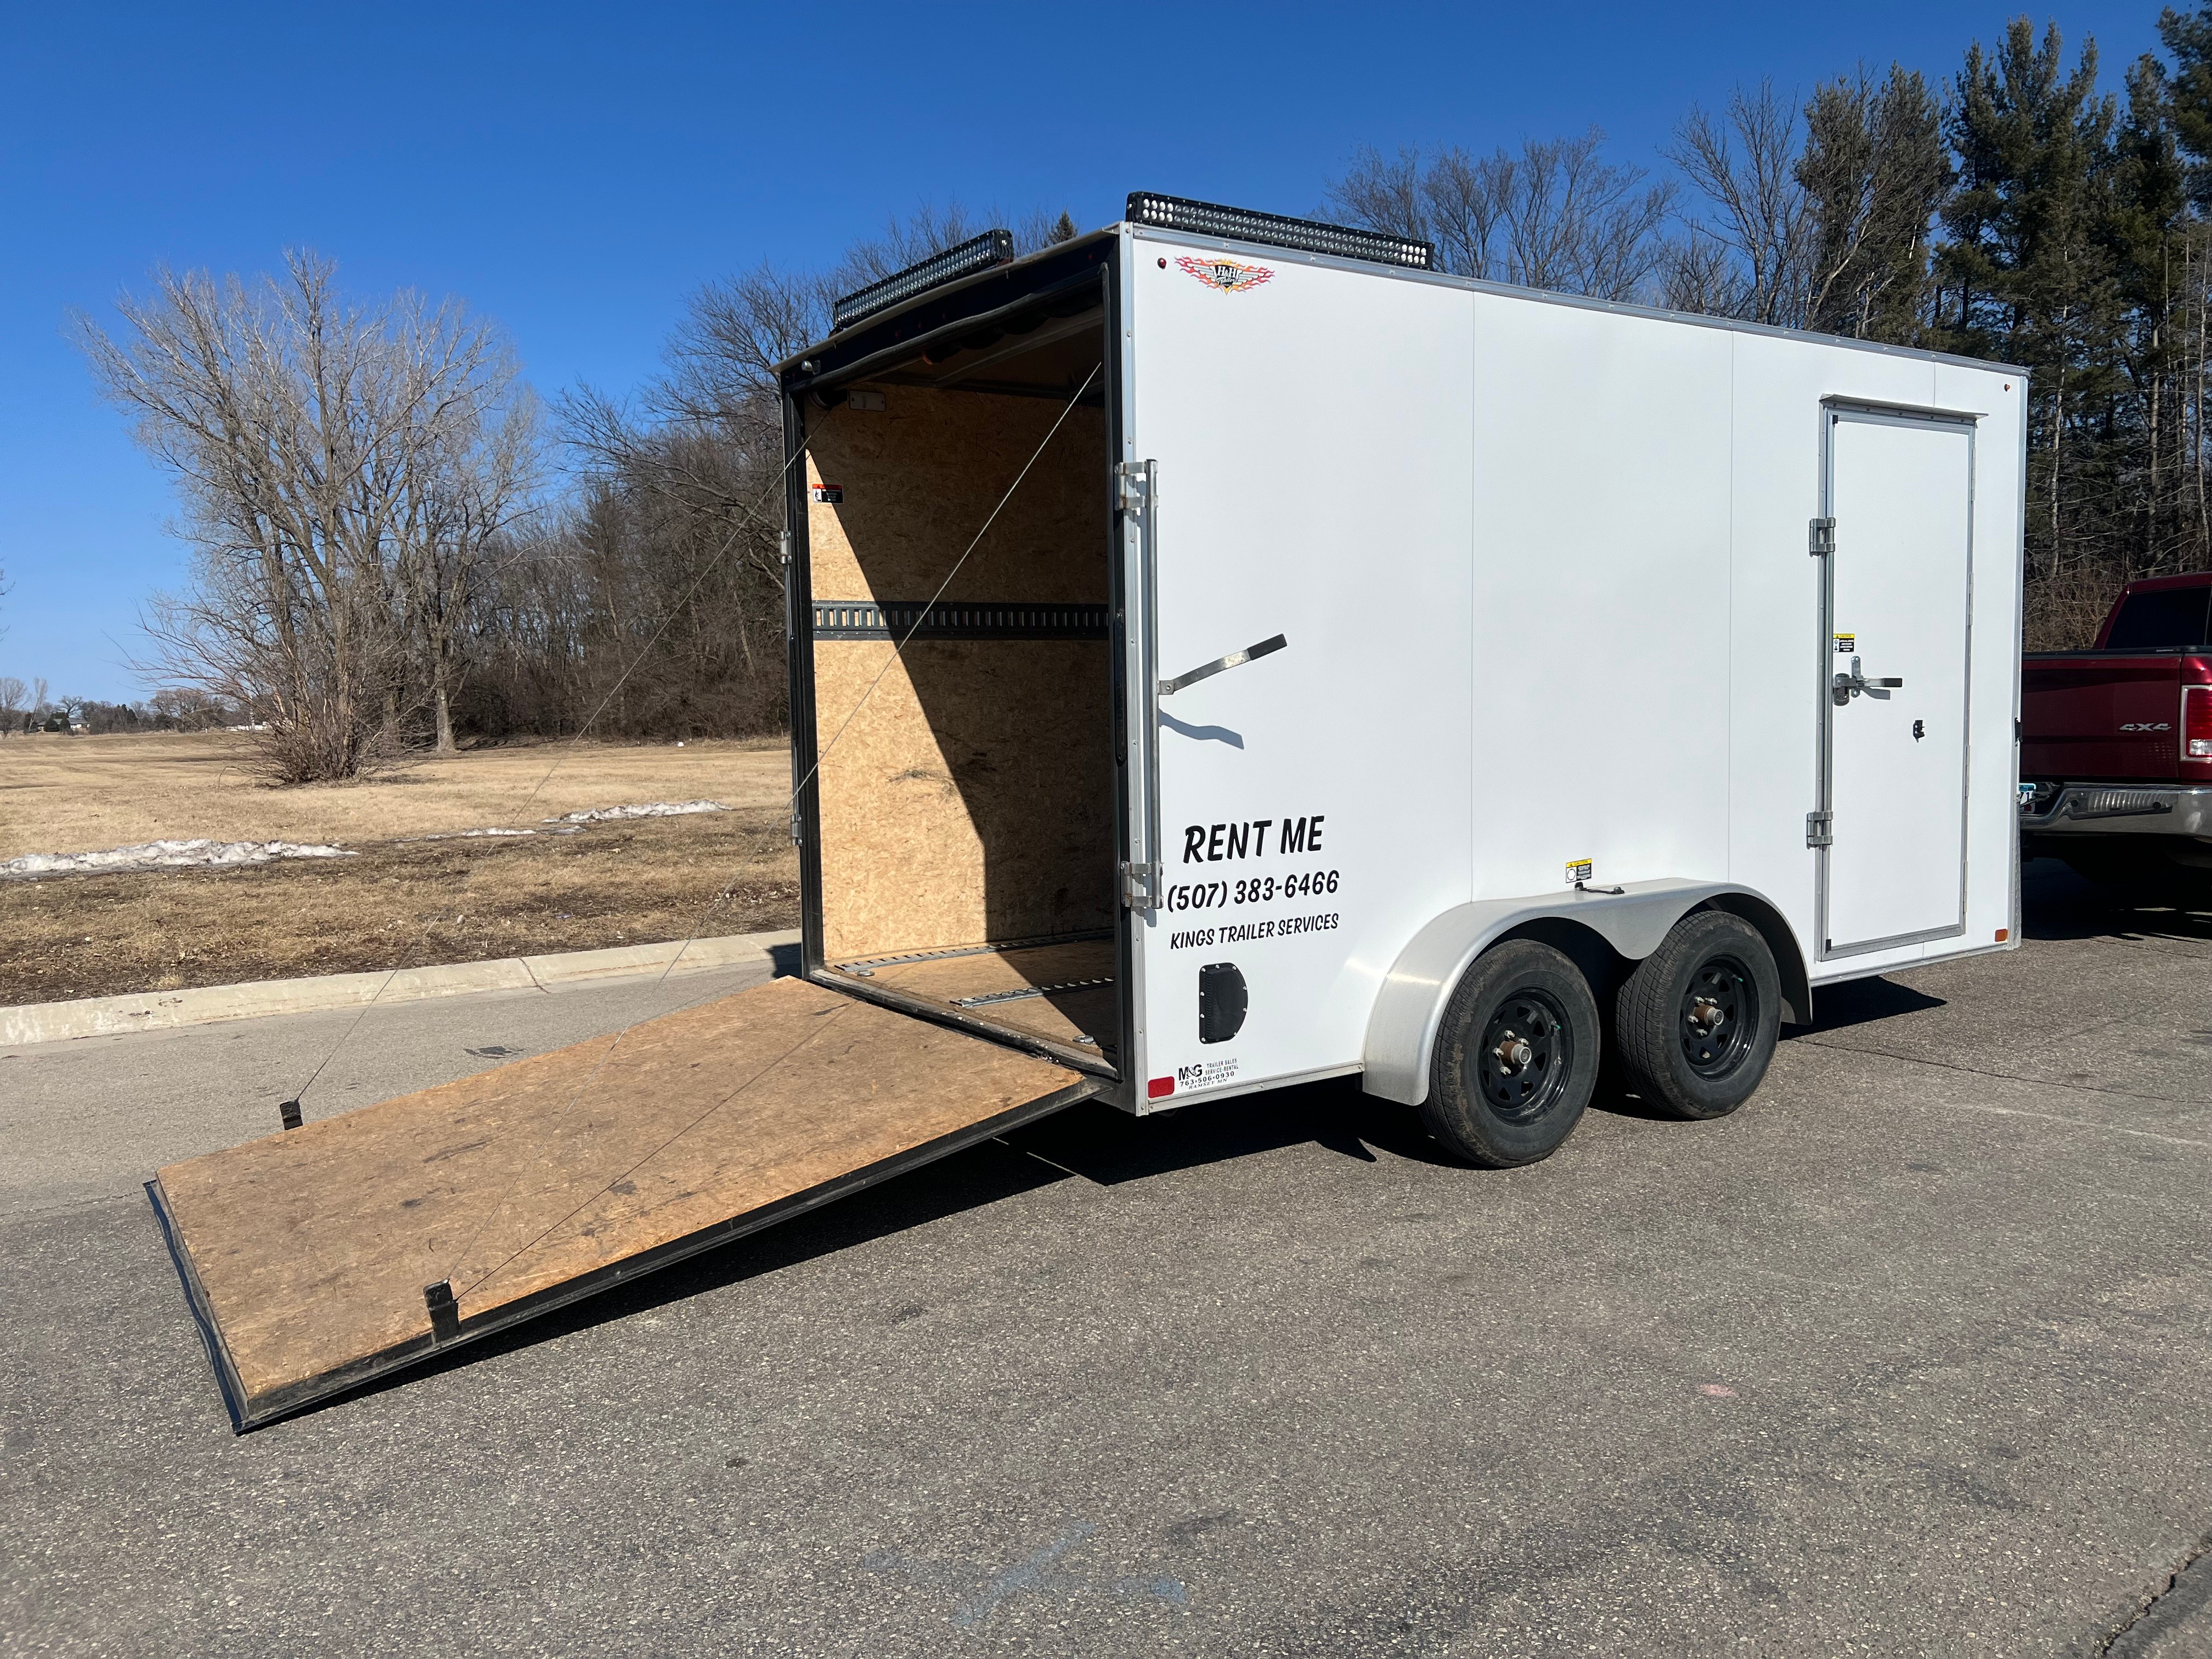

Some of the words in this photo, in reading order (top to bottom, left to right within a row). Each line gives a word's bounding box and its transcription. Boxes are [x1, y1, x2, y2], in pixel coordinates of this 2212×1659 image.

[1217, 266, 1237, 278] H&H
[1183, 820, 1272, 864] RENT
[1280, 815, 1325, 854] ME
[1167, 880, 1228, 913] (507)
[1234, 870, 1340, 905] 383-6466
[1170, 928, 1215, 950] KINGS
[1219, 921, 1275, 944] TRAILER
[1277, 913, 1339, 935] SERVICES
[1206, 1060, 1223, 1069] TRAILER
[1224, 1058, 1237, 1066] SALES
[1178, 1064, 1203, 1081] M&G
[1188, 1080, 1216, 1090] RAMSEY
